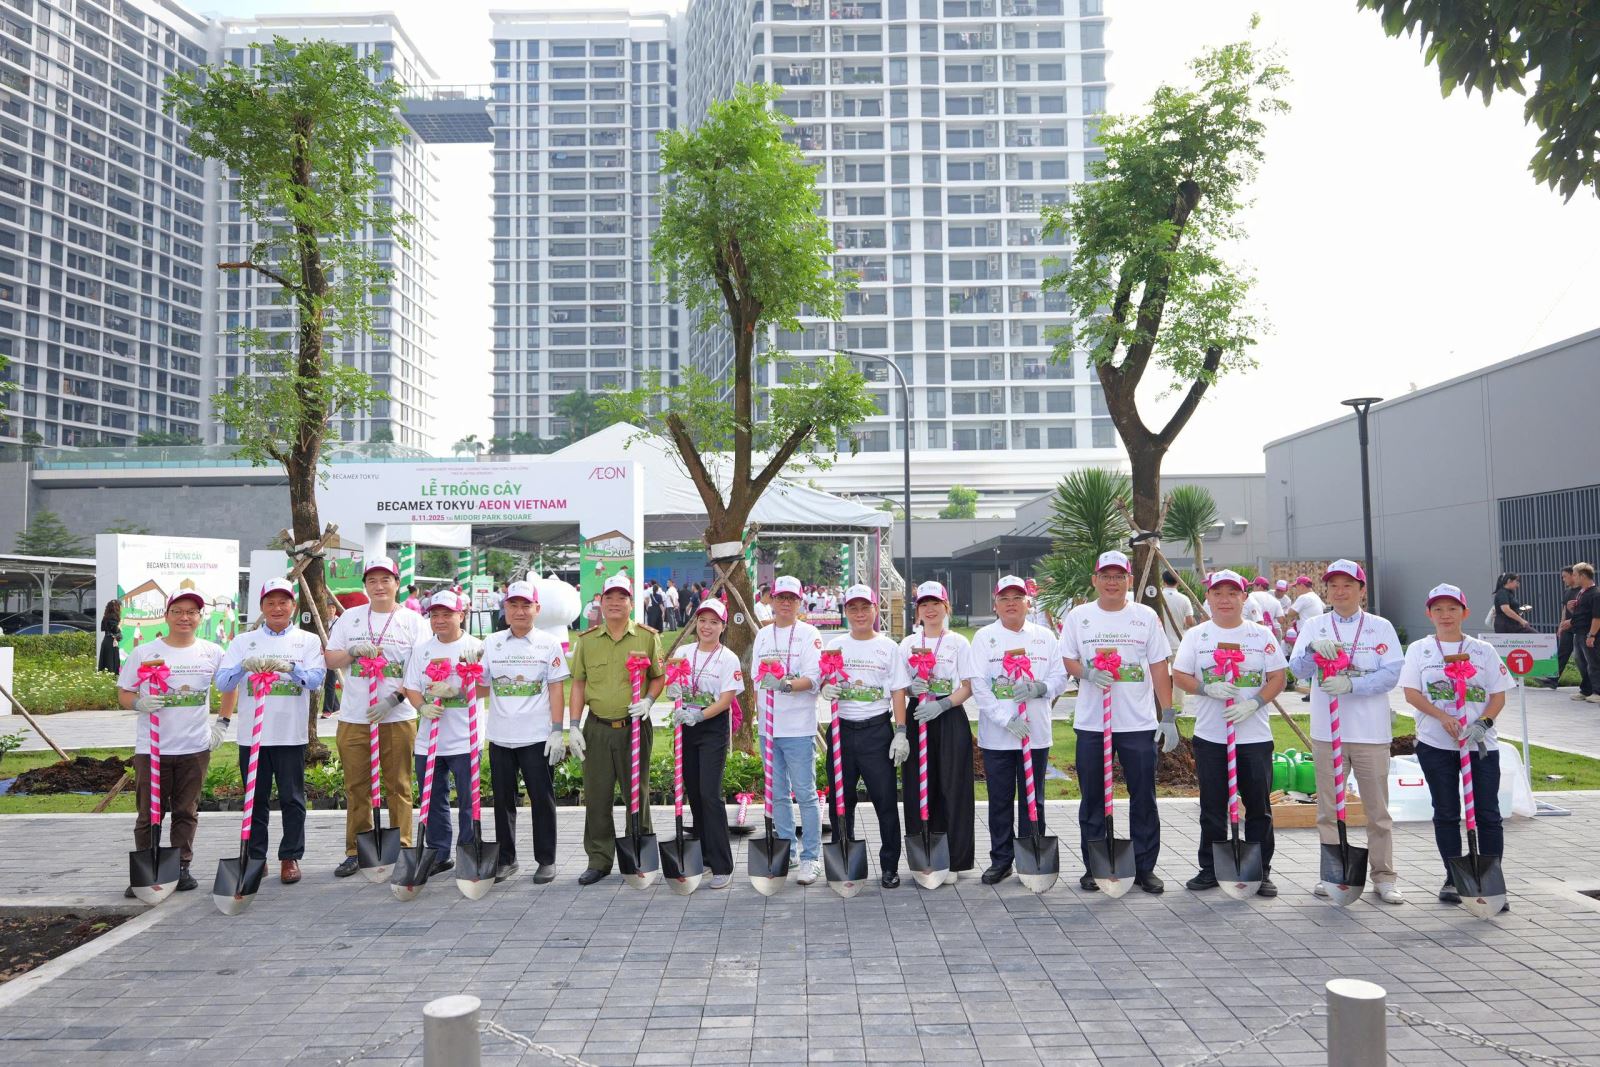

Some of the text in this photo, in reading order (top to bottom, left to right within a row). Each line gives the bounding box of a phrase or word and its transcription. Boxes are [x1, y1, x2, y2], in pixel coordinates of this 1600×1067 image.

[422, 478, 522, 496] LỄ TRỒNG CÂY
[377, 499, 567, 511] BECAMEX TOKYU AEON VIETNAM
[1515, 659, 1524, 672] 1
